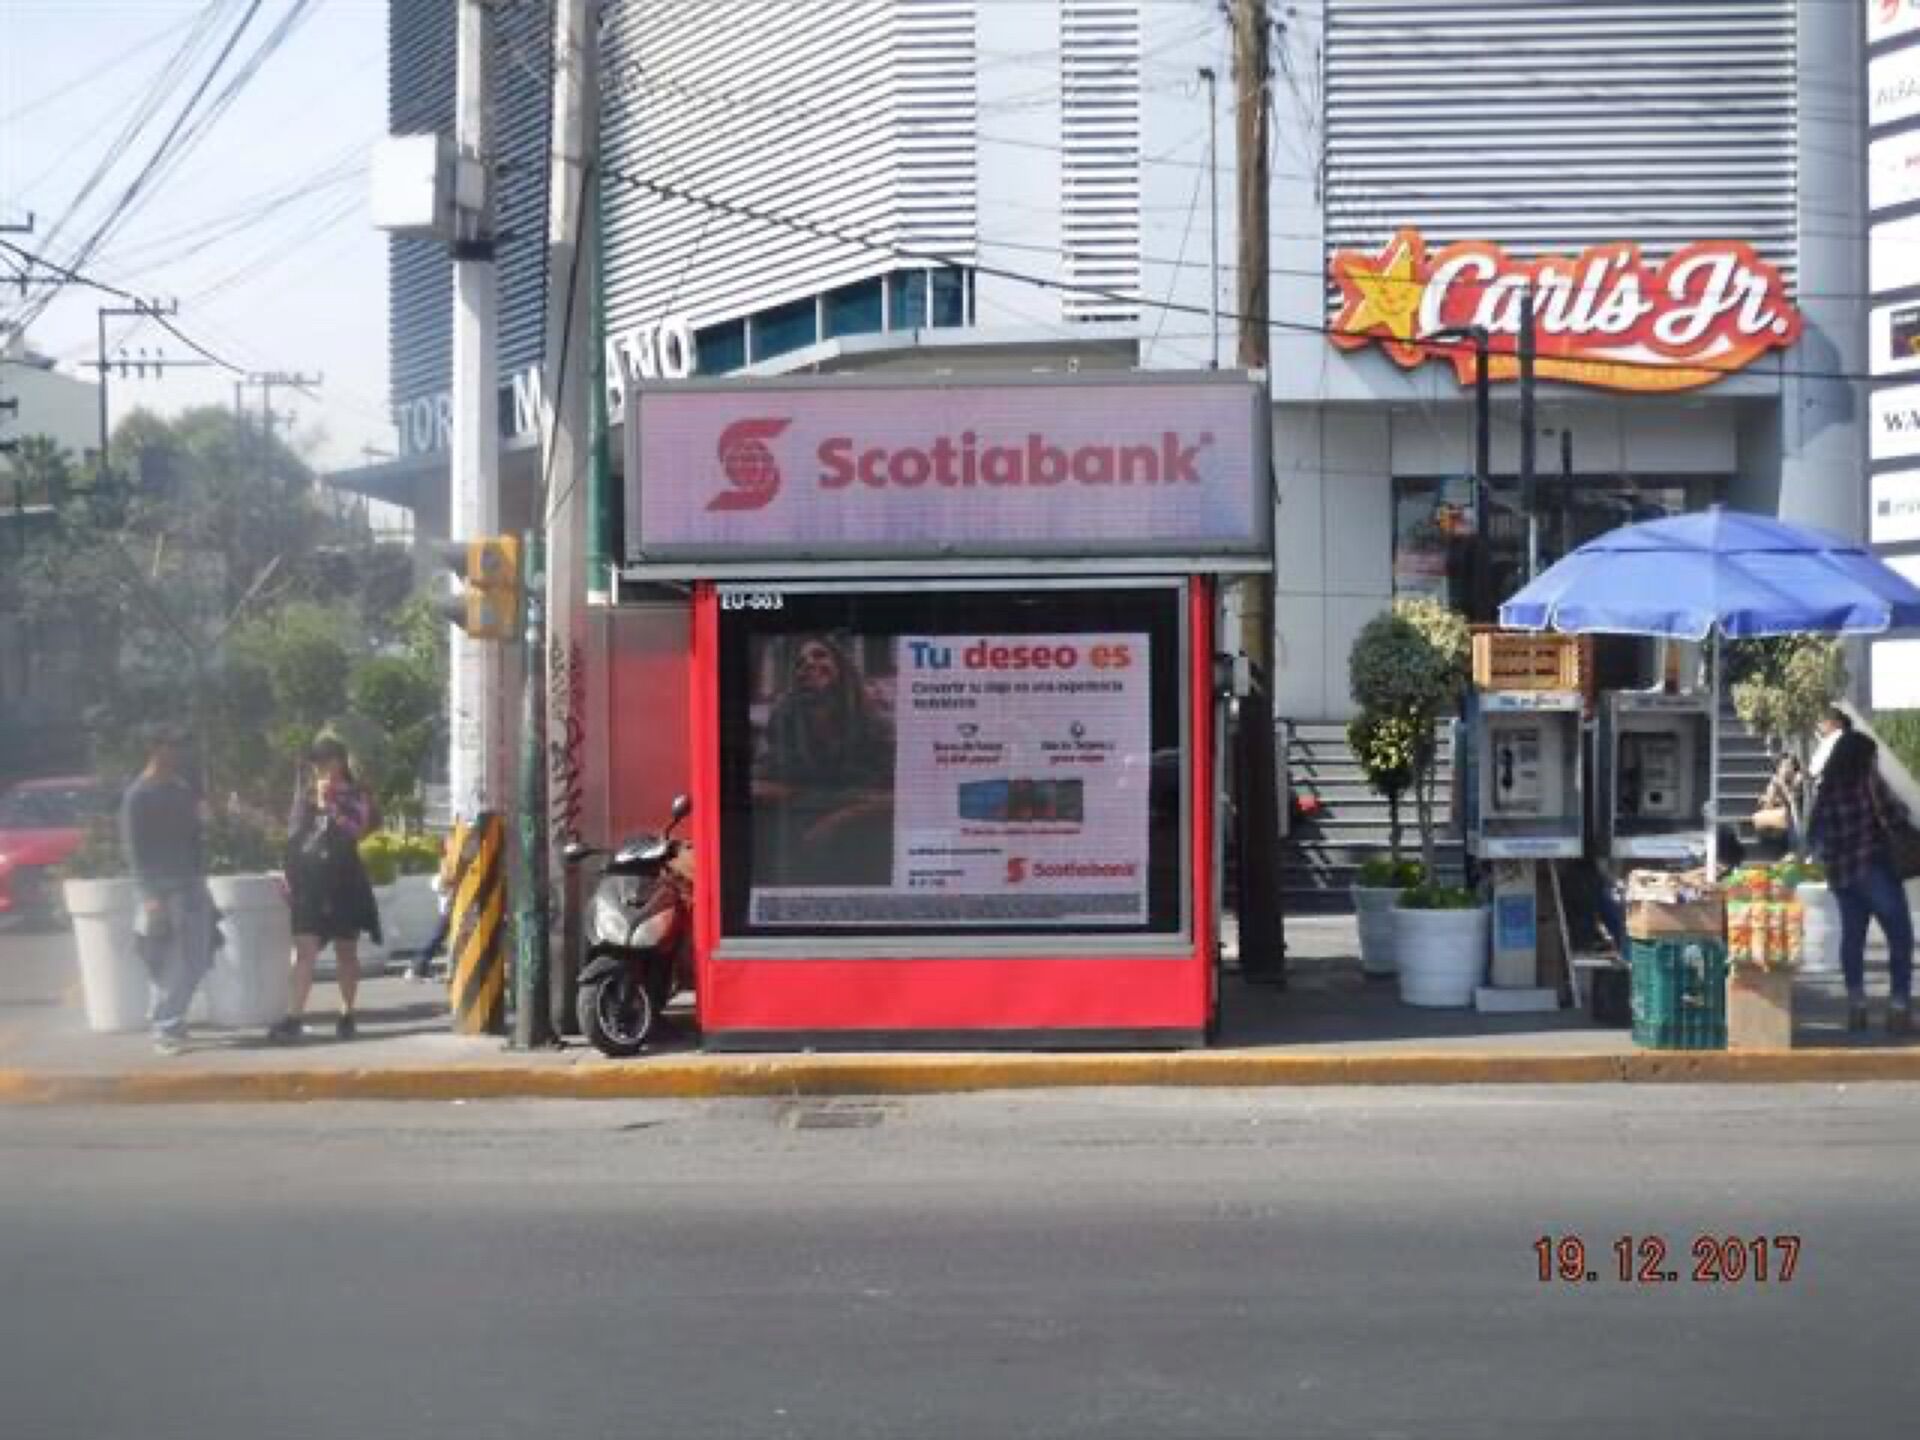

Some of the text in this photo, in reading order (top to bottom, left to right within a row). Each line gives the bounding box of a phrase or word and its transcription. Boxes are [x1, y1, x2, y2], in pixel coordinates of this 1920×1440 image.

[1418, 251, 1788, 345] Carl's Jr.
[817, 431, 1203, 489] Scotiabank
[909, 639, 1131, 670] Tu deseo es
